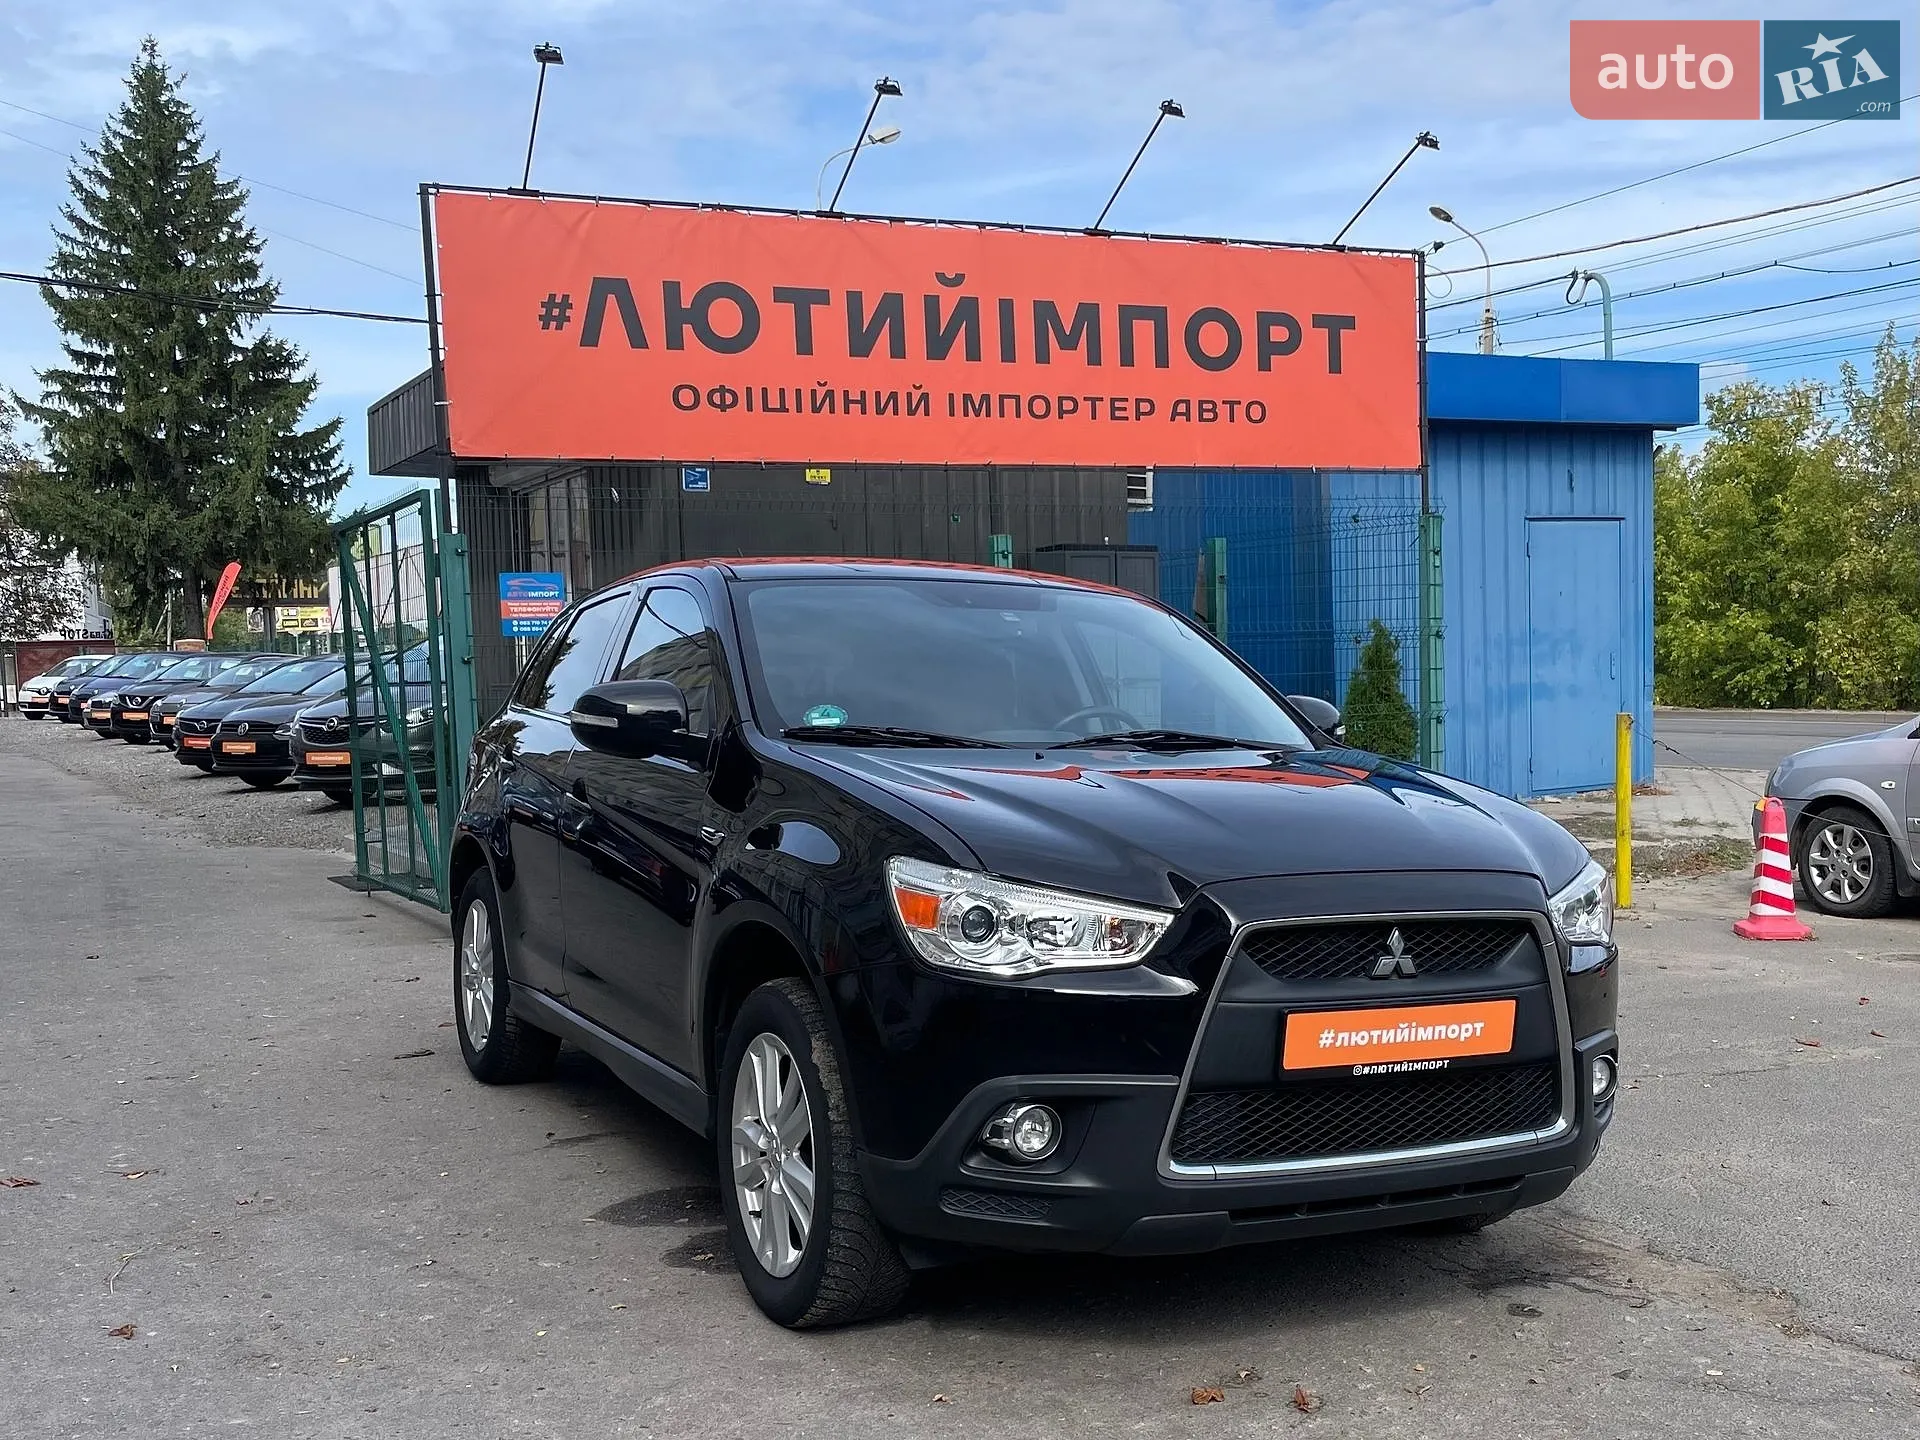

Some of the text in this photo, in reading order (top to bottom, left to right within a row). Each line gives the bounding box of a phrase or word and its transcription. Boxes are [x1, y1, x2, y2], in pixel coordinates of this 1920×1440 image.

[538, 272, 1356, 374] #ЛЮТИЙІМПОРТ
[672, 380, 1267, 424] ОФІЦІЙНИЙ ІМПОРТЕР АВТО
[1318, 1021, 1484, 1048] #лютийімпорт
[1362, 1059, 1450, 1075] #ЛЮТИЙІМПОРТ
